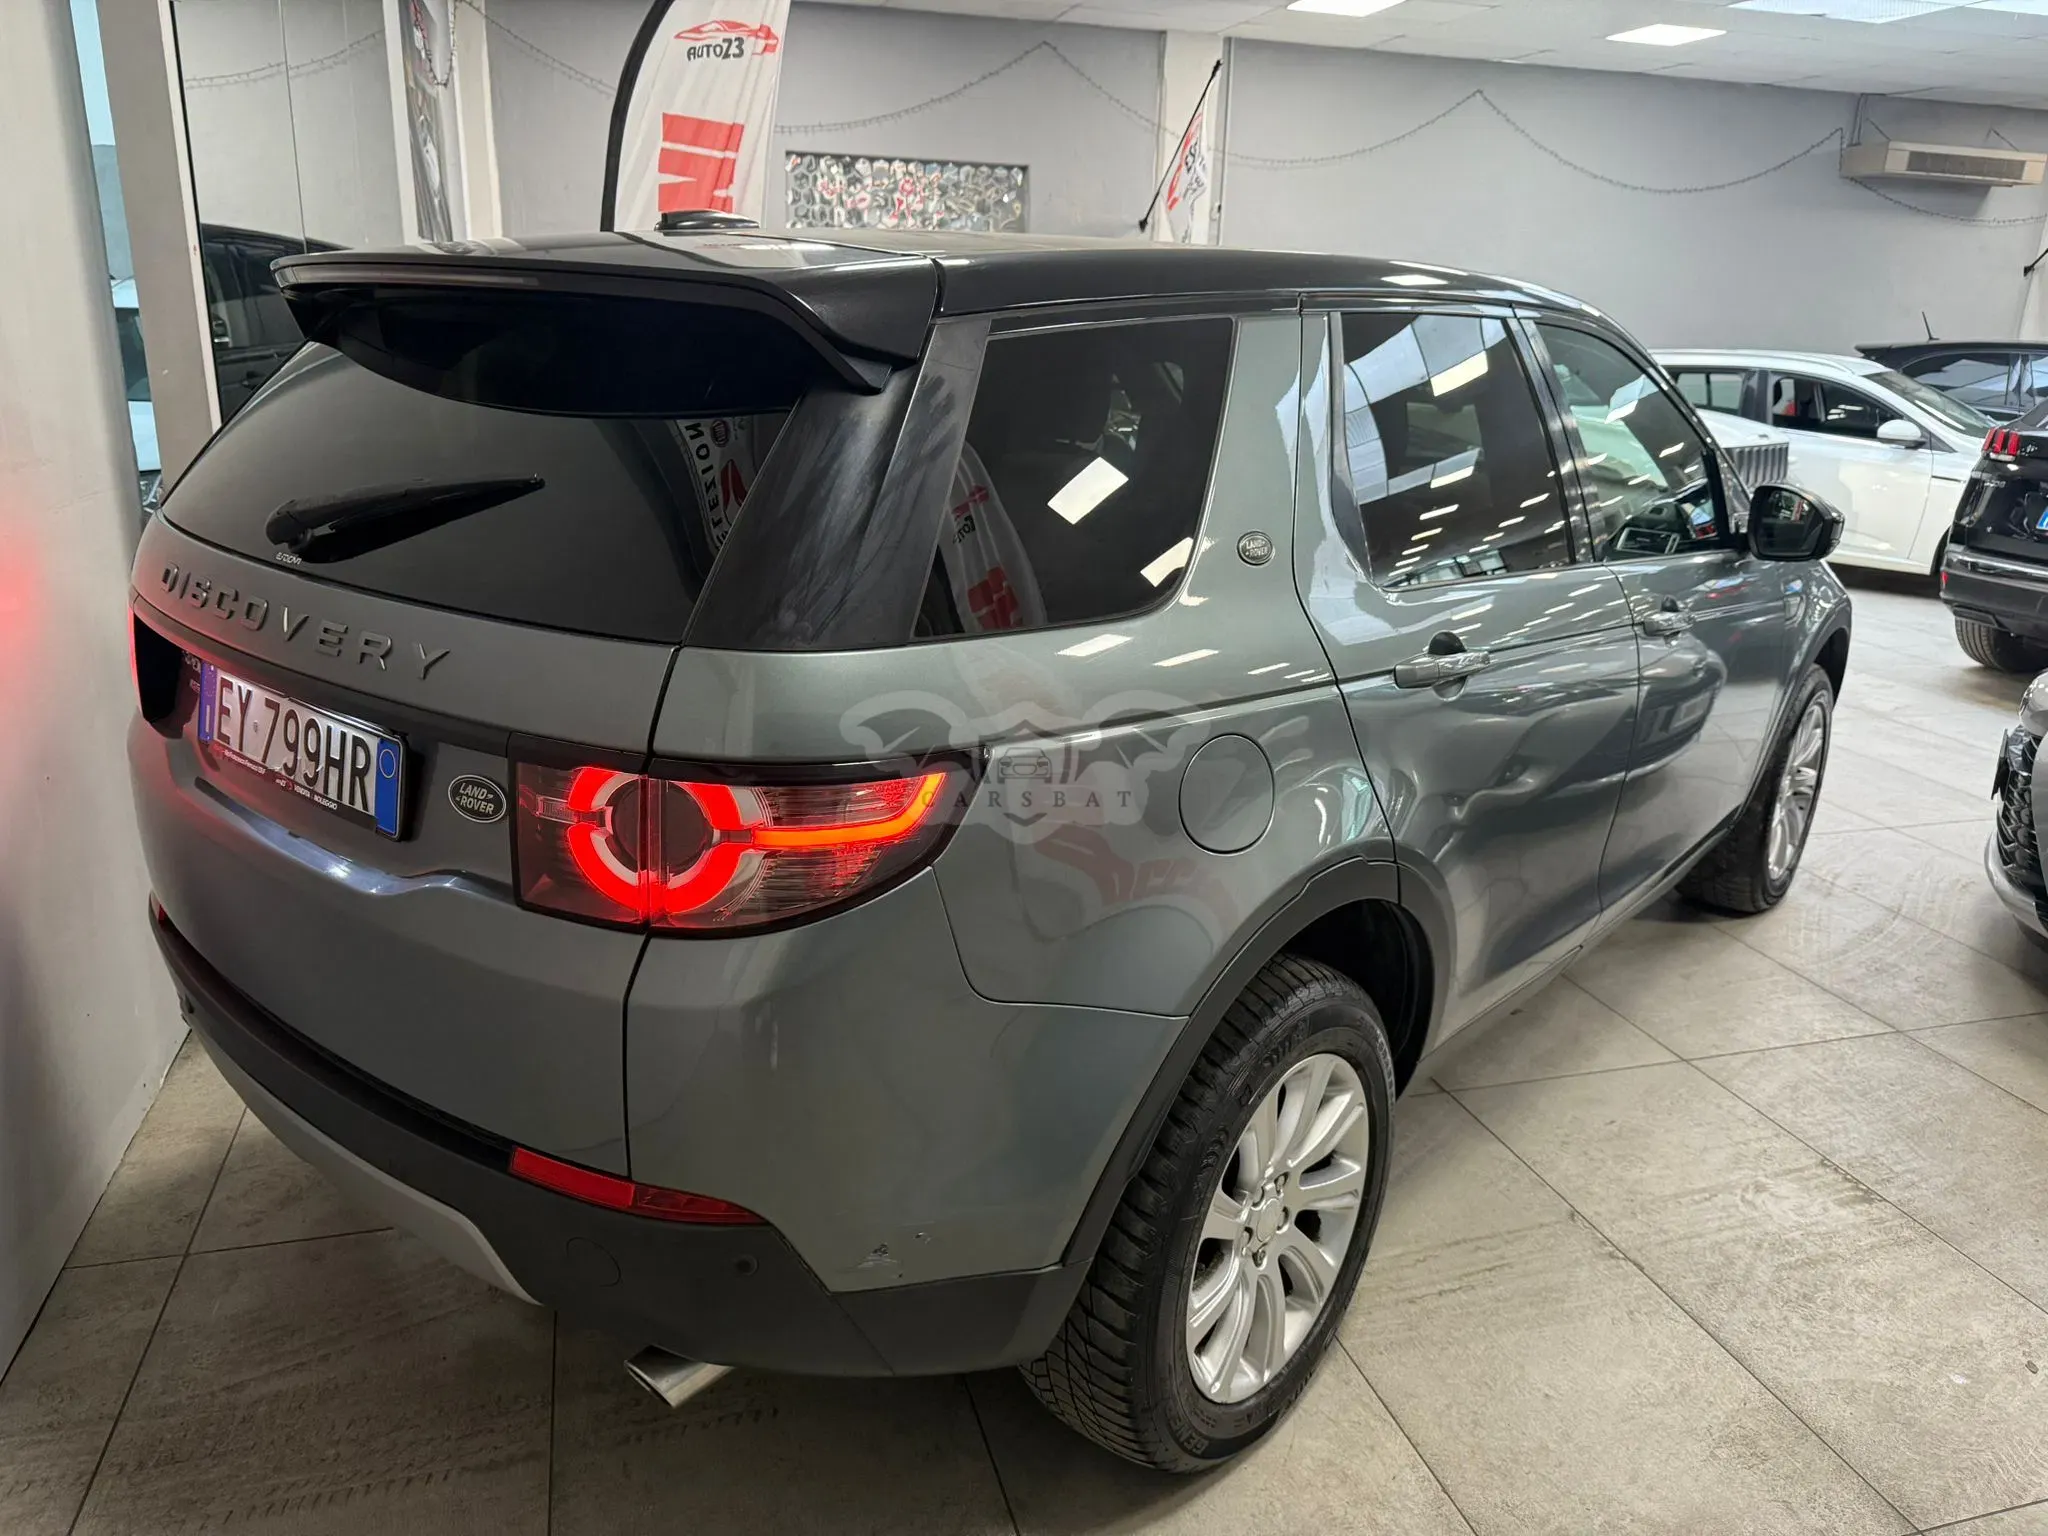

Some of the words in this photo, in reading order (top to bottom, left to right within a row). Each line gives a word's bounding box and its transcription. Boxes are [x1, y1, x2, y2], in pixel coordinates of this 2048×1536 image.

[686, 37, 745, 61] AUTO23
[160, 562, 450, 680] DISCOVERY
[460, 782, 488, 800] LAND
[460, 795, 495, 815] ROVER
